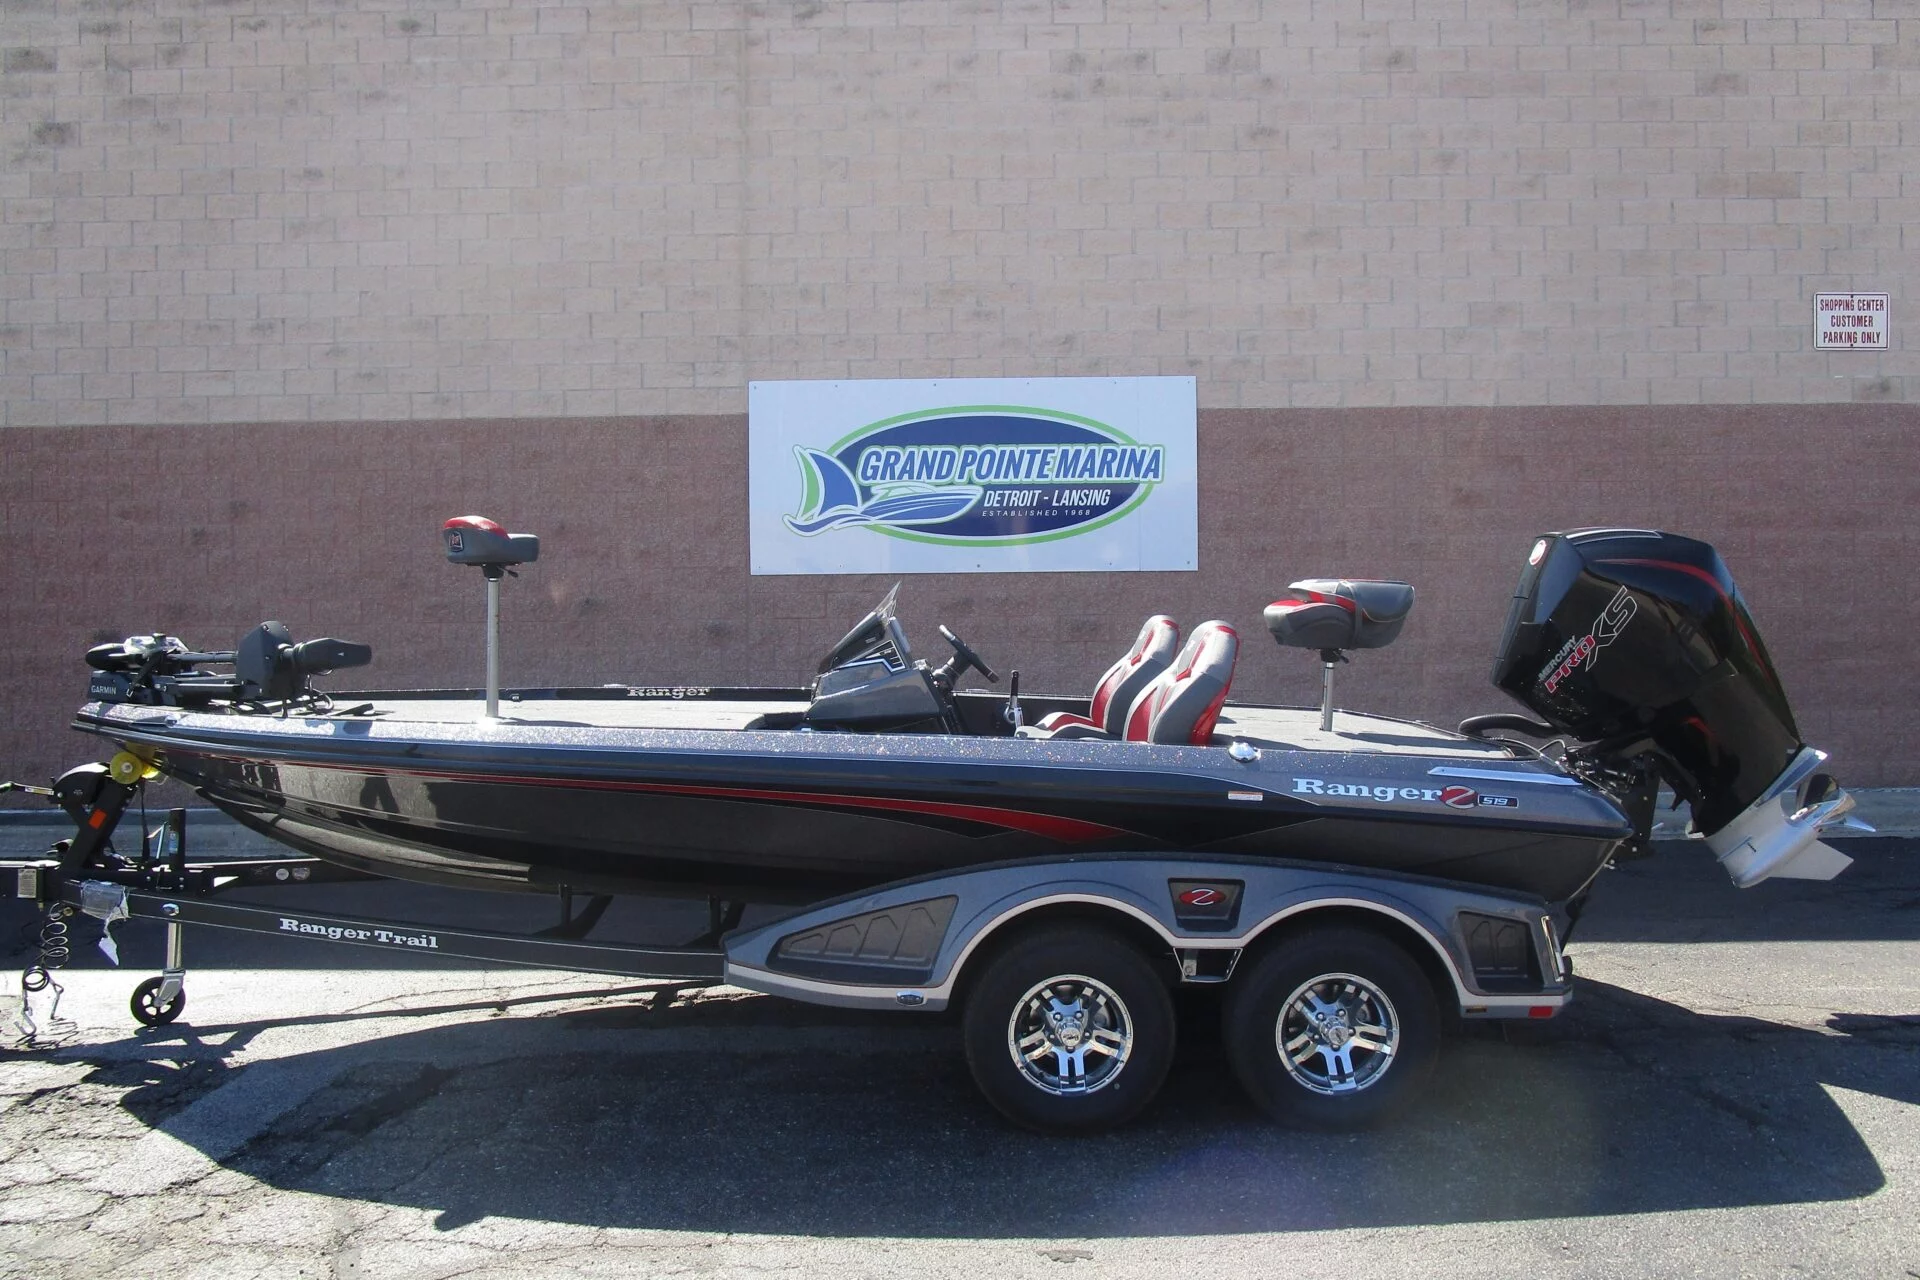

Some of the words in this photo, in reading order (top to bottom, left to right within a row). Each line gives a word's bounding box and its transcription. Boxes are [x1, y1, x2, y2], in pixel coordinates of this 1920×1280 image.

[1820, 299, 1855, 311] SHOPPING
[1857, 299, 1885, 311] CENTER
[1831, 315, 1874, 327] CUSTOMER
[1823, 331, 1858, 344] PARKING
[1861, 331, 1881, 344] ONLY
[860, 448, 957, 481] GRAND
[957, 448, 1052, 481] POINTE
[1055, 447, 1162, 481] MARINA
[983, 490, 1042, 507] DETROIT
[1051, 489, 1111, 506] LANSING
[982, 509, 1058, 517] ESTABLISHED
[1064, 508, 1091, 516] 1968
[1538, 635, 1577, 681] MERCURY
[91, 685, 117, 695] GARMIN
[626, 686, 710, 699] Ranger
[1292, 778, 1443, 802] Ranger
[279, 918, 371, 940] Ranger
[374, 930, 439, 949] Trail
